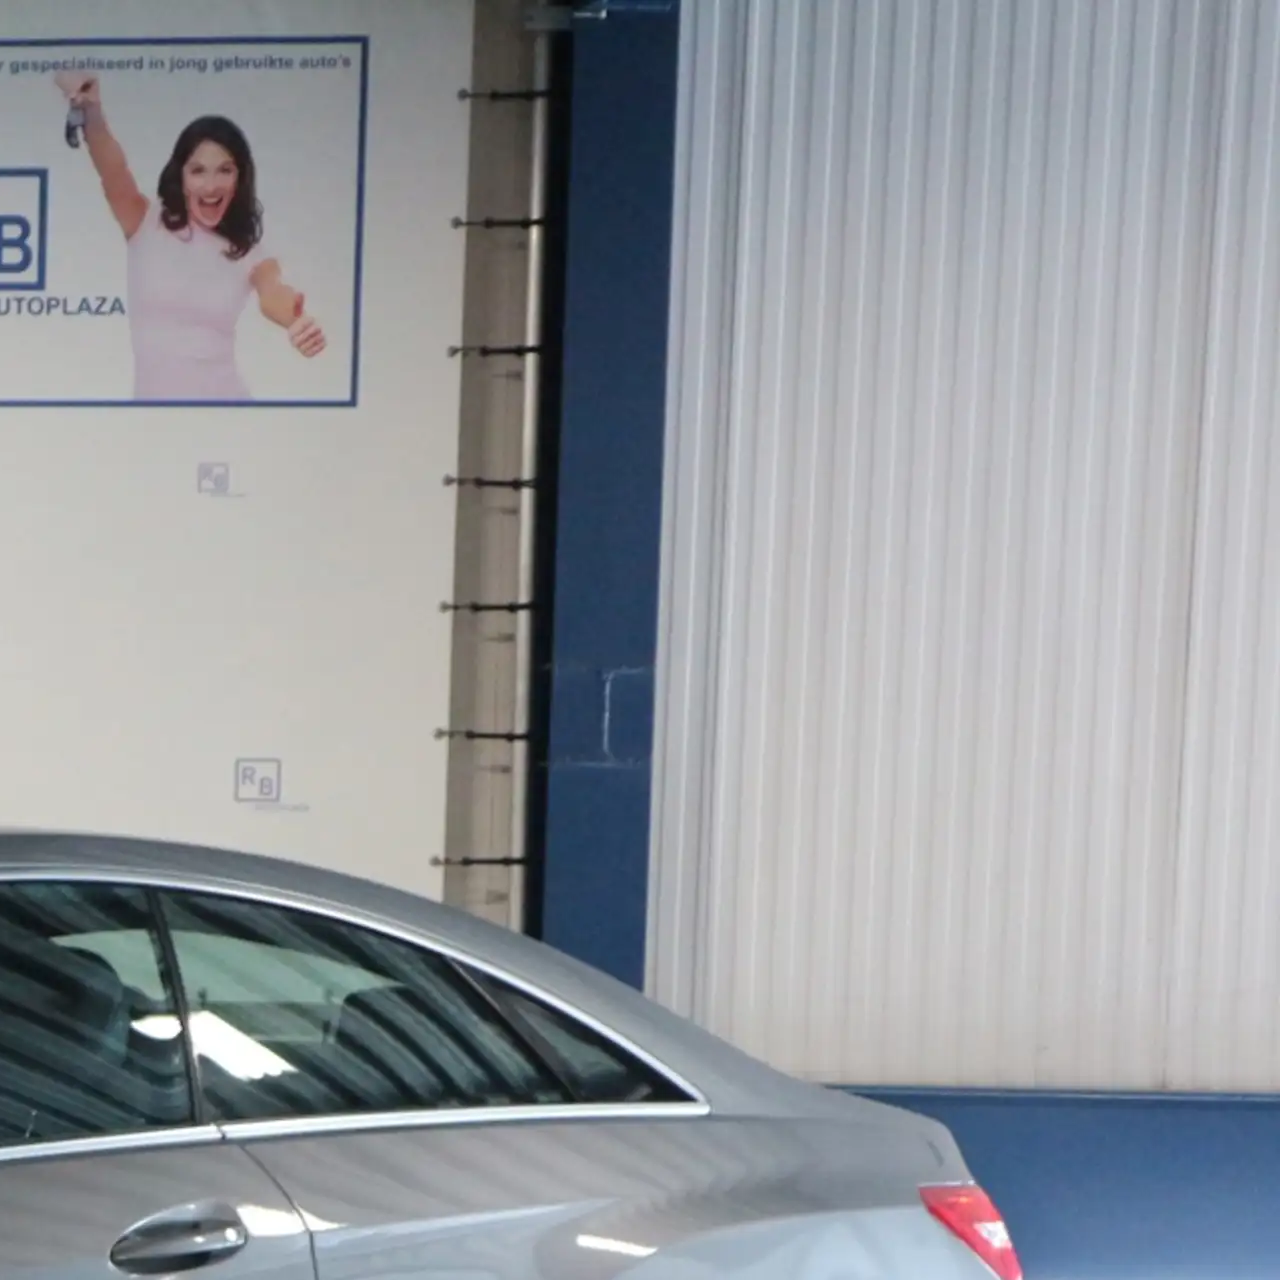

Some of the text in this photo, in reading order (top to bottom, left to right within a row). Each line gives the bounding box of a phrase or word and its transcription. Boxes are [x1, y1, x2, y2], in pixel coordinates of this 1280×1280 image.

[9, 55, 144, 75] gespecialiseerd
[149, 55, 165, 70] in
[169, 55, 208, 73] jong
[213, 54, 294, 73] gebruikte
[299, 54, 352, 70] auto's
